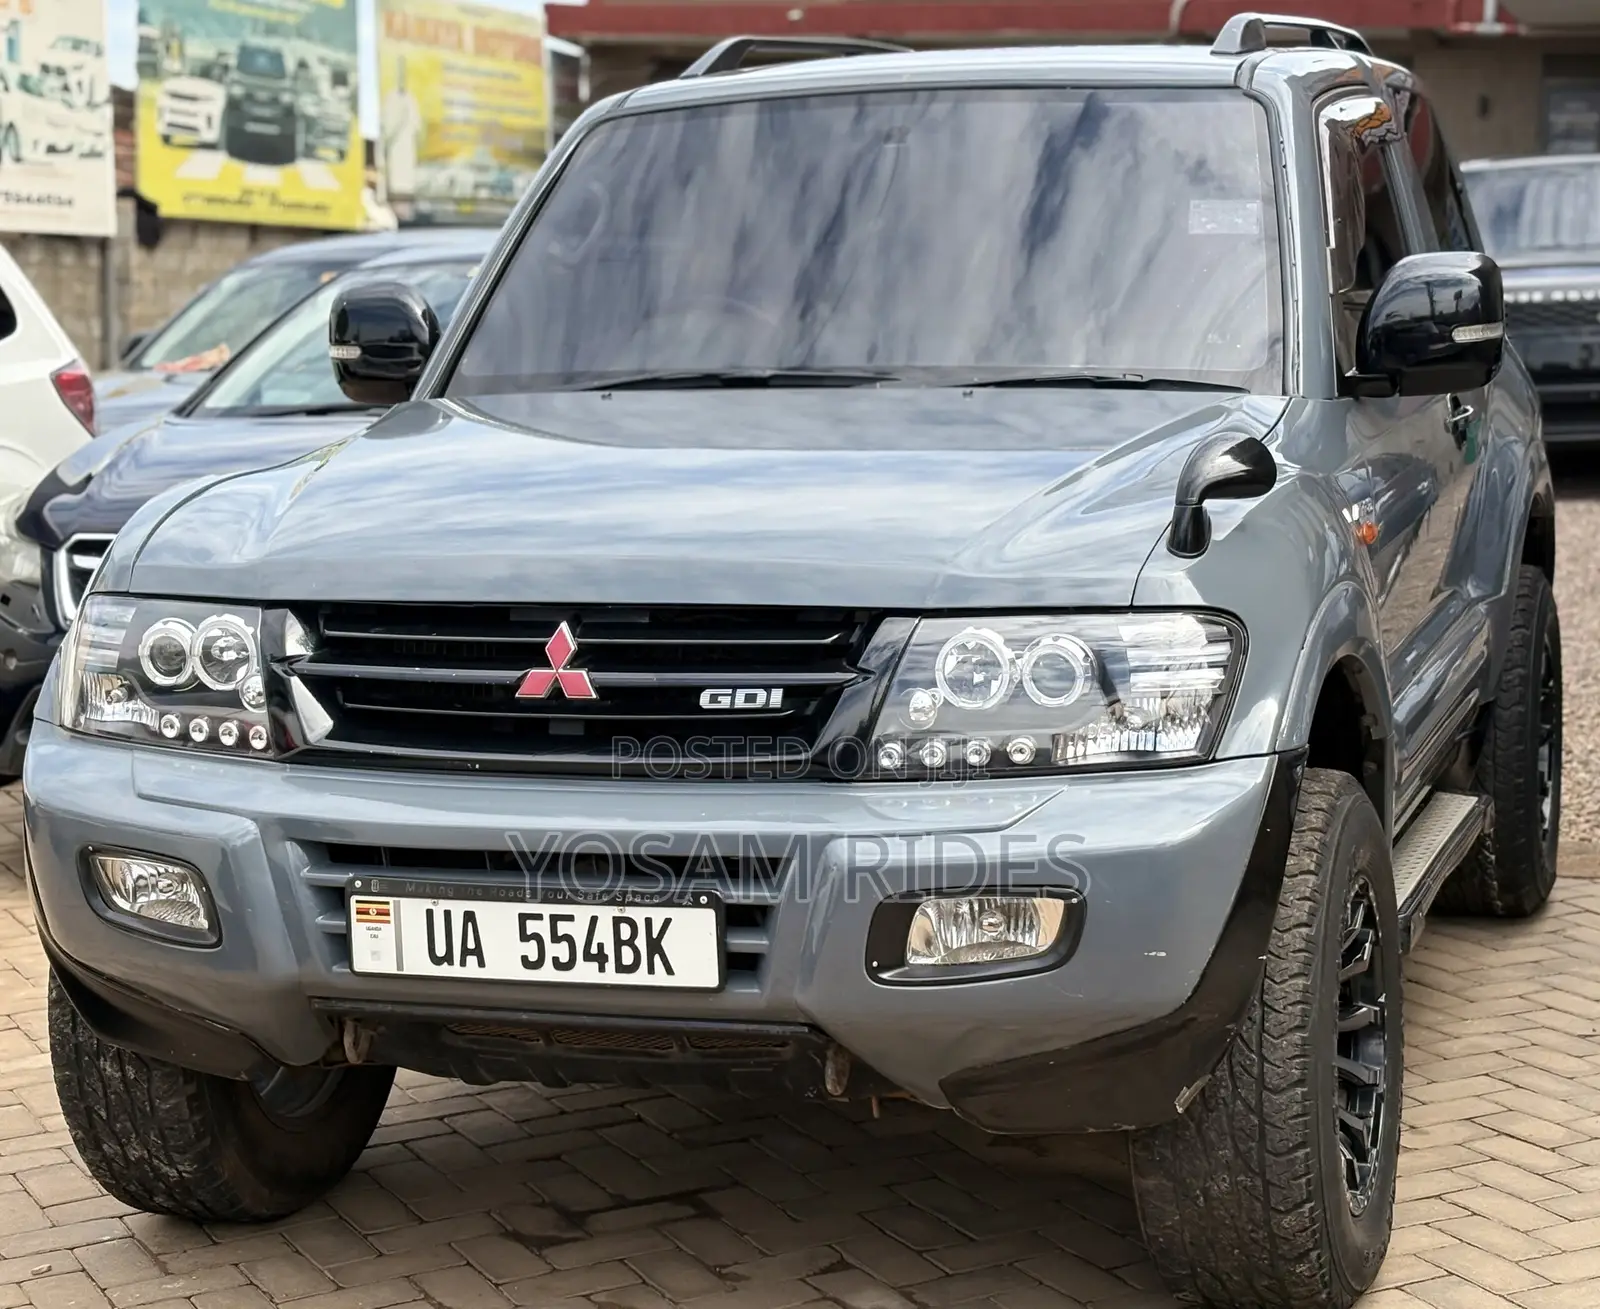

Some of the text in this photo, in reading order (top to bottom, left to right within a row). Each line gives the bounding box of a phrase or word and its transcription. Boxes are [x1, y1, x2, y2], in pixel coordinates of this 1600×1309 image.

[699, 688, 783, 709] GDI
[615, 891, 661, 905] Space
[425, 908, 676, 976] UA 554BK
